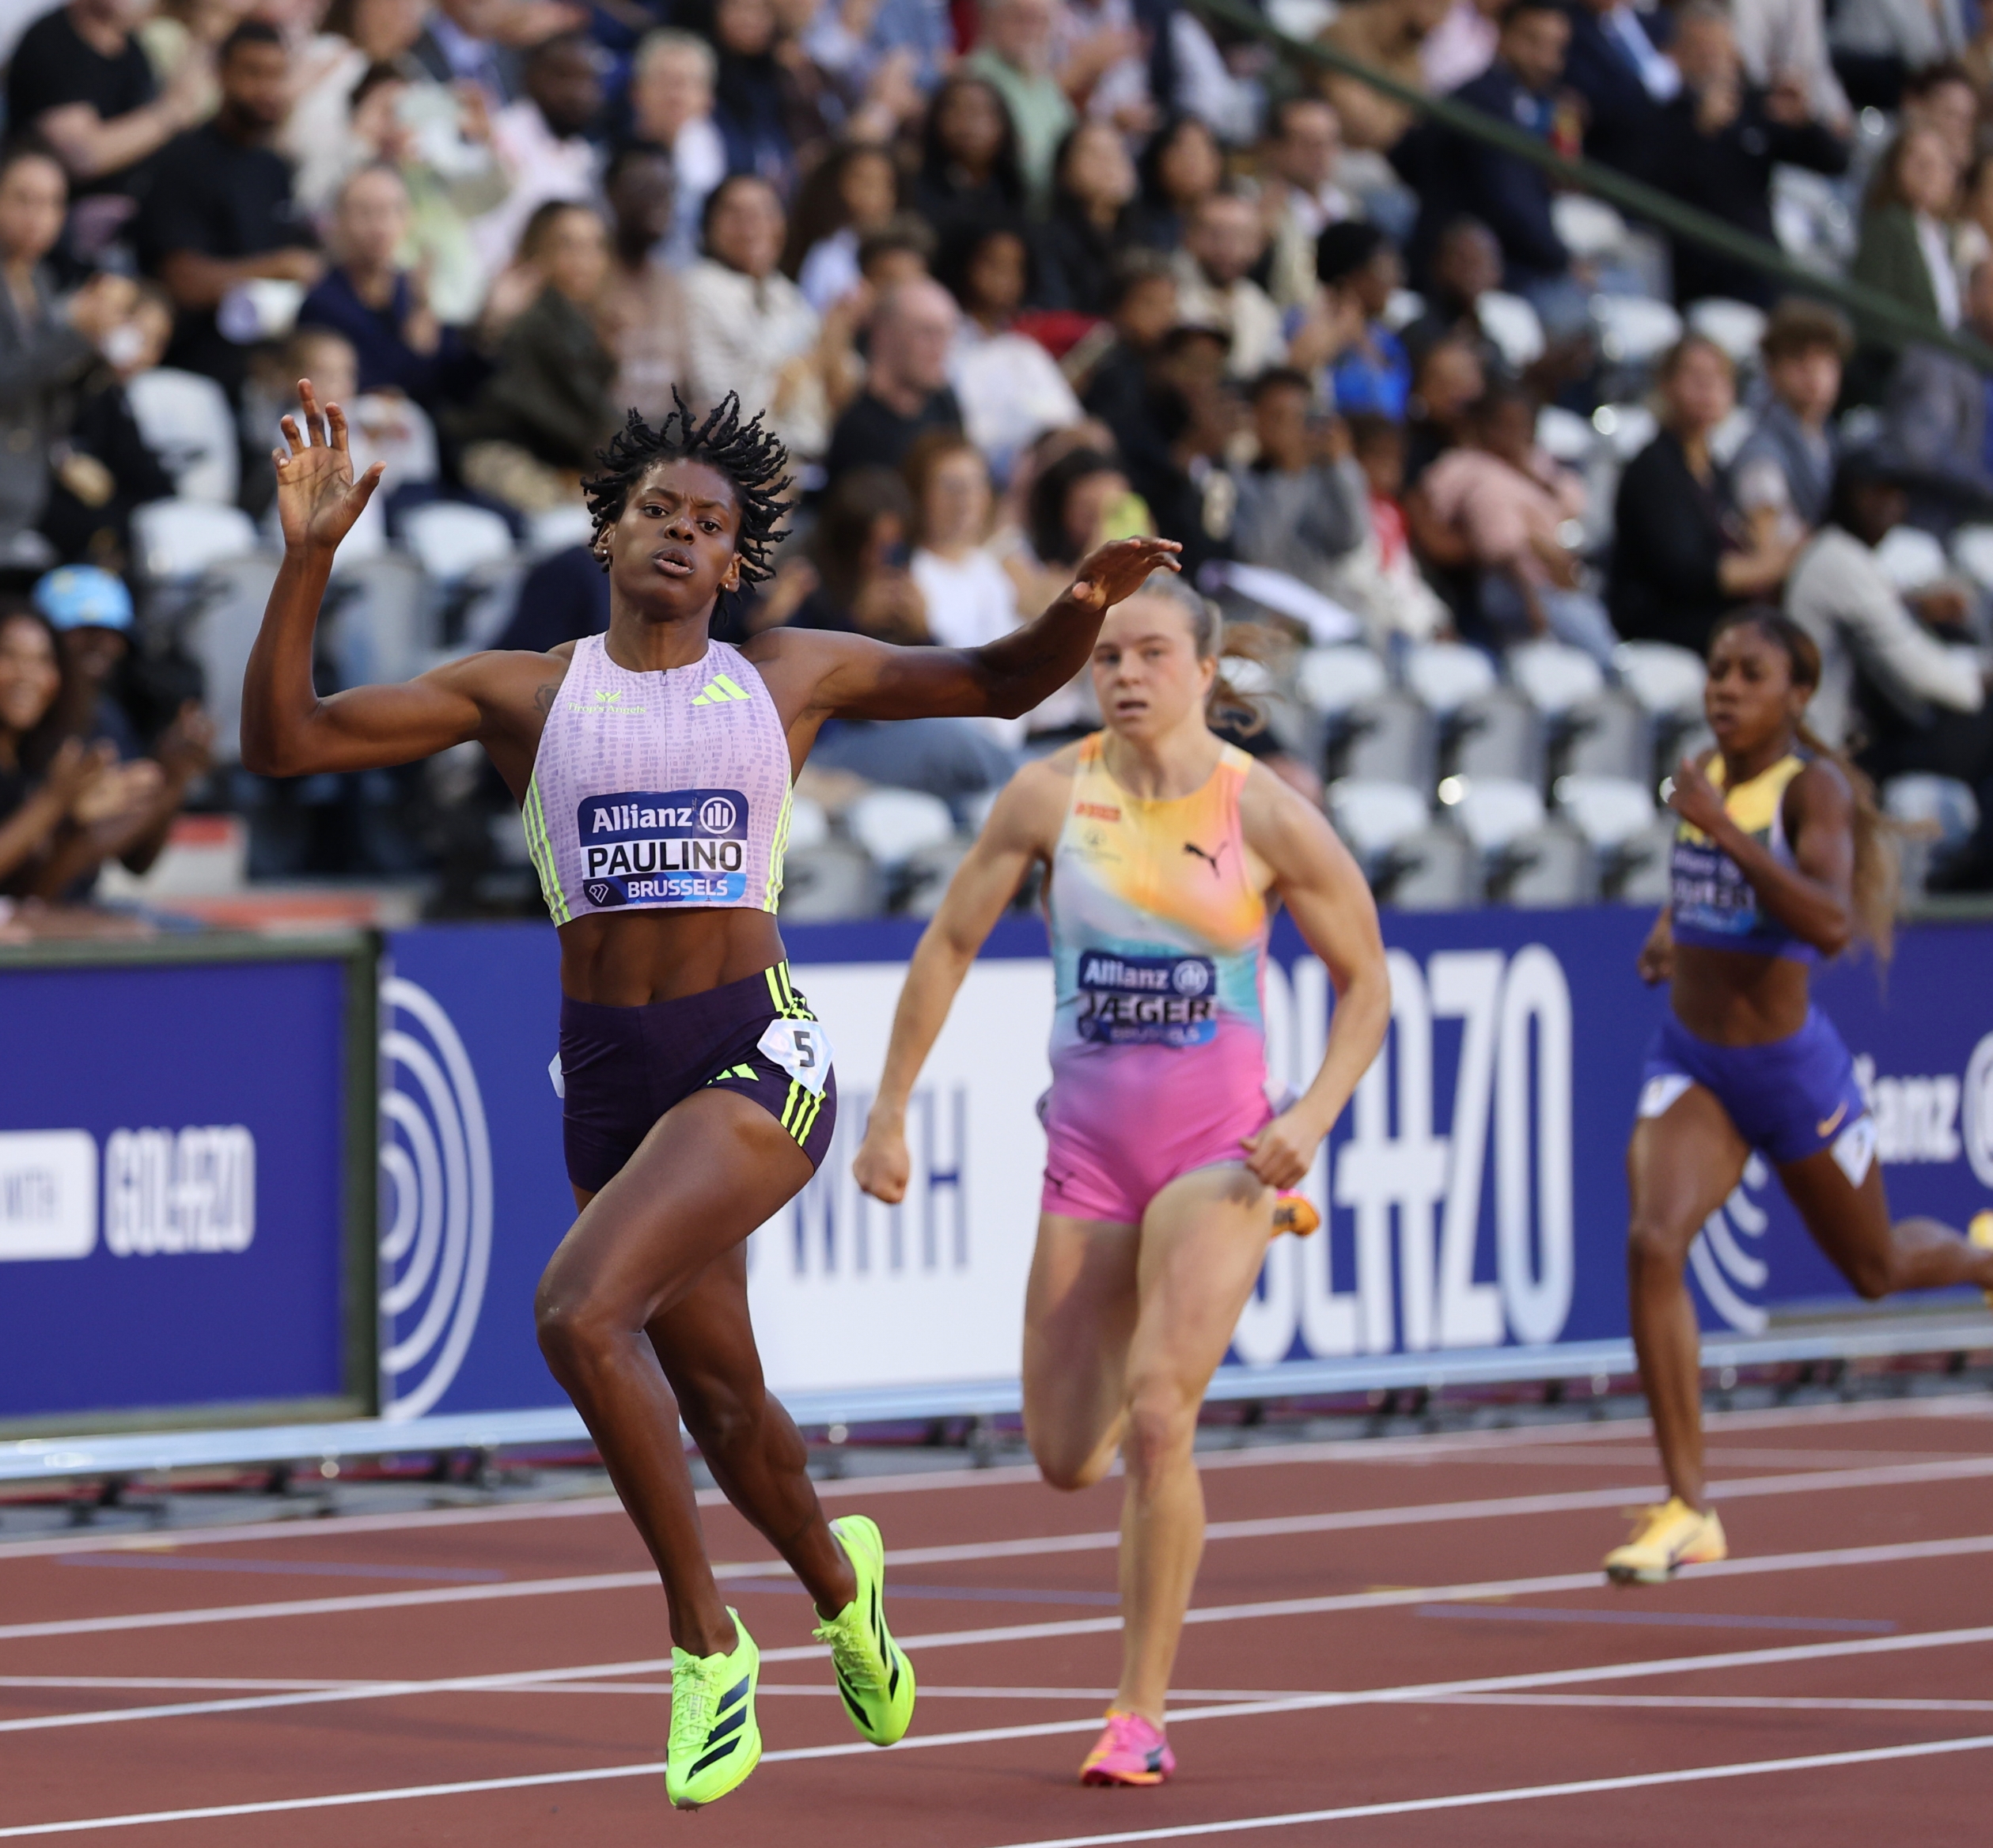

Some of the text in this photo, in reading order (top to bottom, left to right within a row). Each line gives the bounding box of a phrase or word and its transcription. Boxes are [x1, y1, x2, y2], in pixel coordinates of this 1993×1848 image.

[567, 702, 647, 714] Tirop's Angels
[593, 804, 693, 834] Allianz
[588, 840, 742, 878] PAULINO
[627, 879, 729, 899] BRUSSELS
[1083, 958, 1169, 990] Allianz
[794, 1031, 815, 1067] 5
